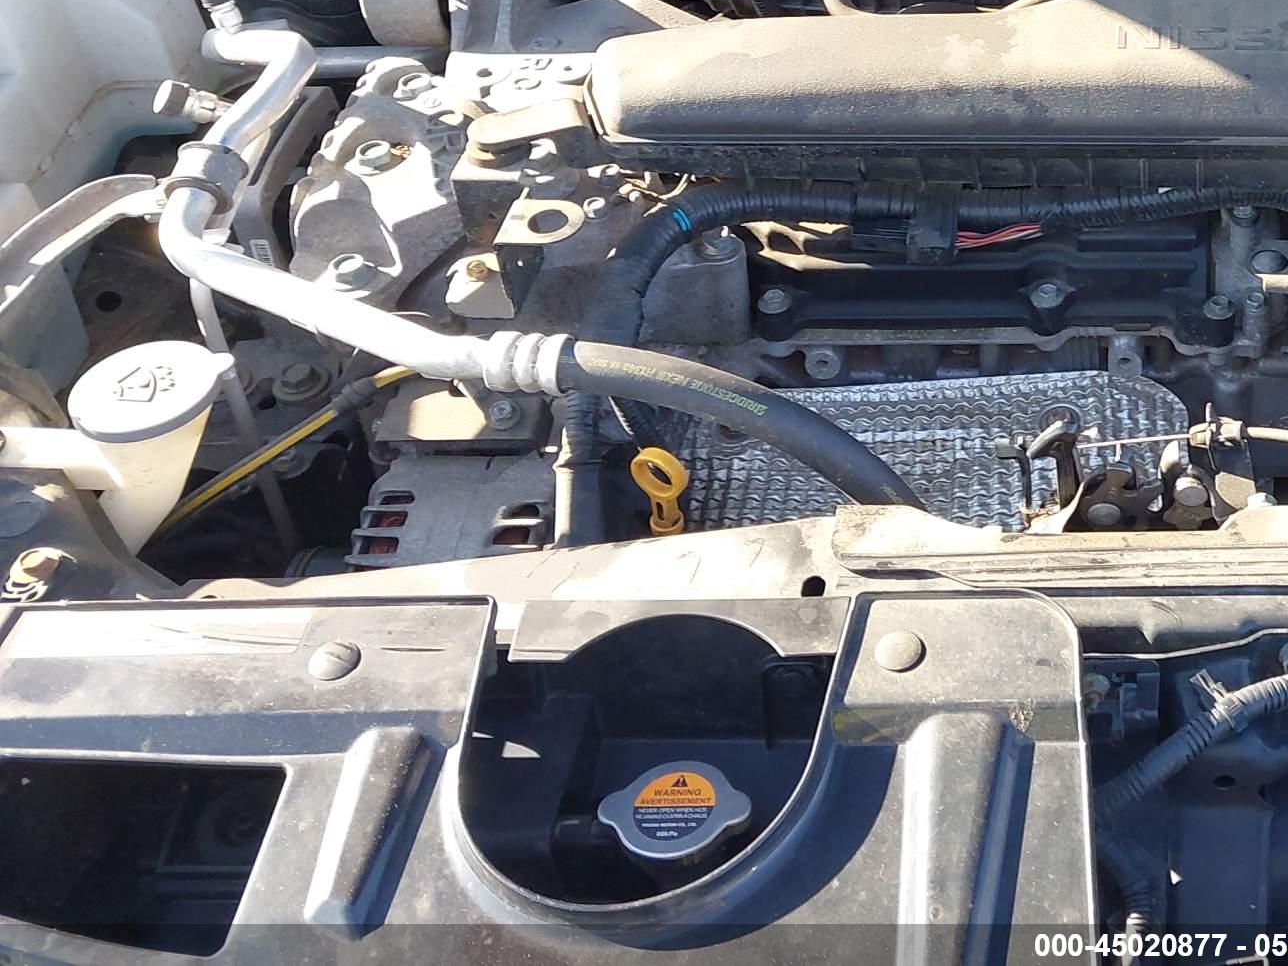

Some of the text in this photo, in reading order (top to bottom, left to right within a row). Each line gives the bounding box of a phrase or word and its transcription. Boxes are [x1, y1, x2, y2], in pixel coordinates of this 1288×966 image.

[689, 378, 769, 417] BRIDGESTONE
[653, 788, 702, 797] WARNING
[639, 797, 712, 805] AVERTISSEMENT
